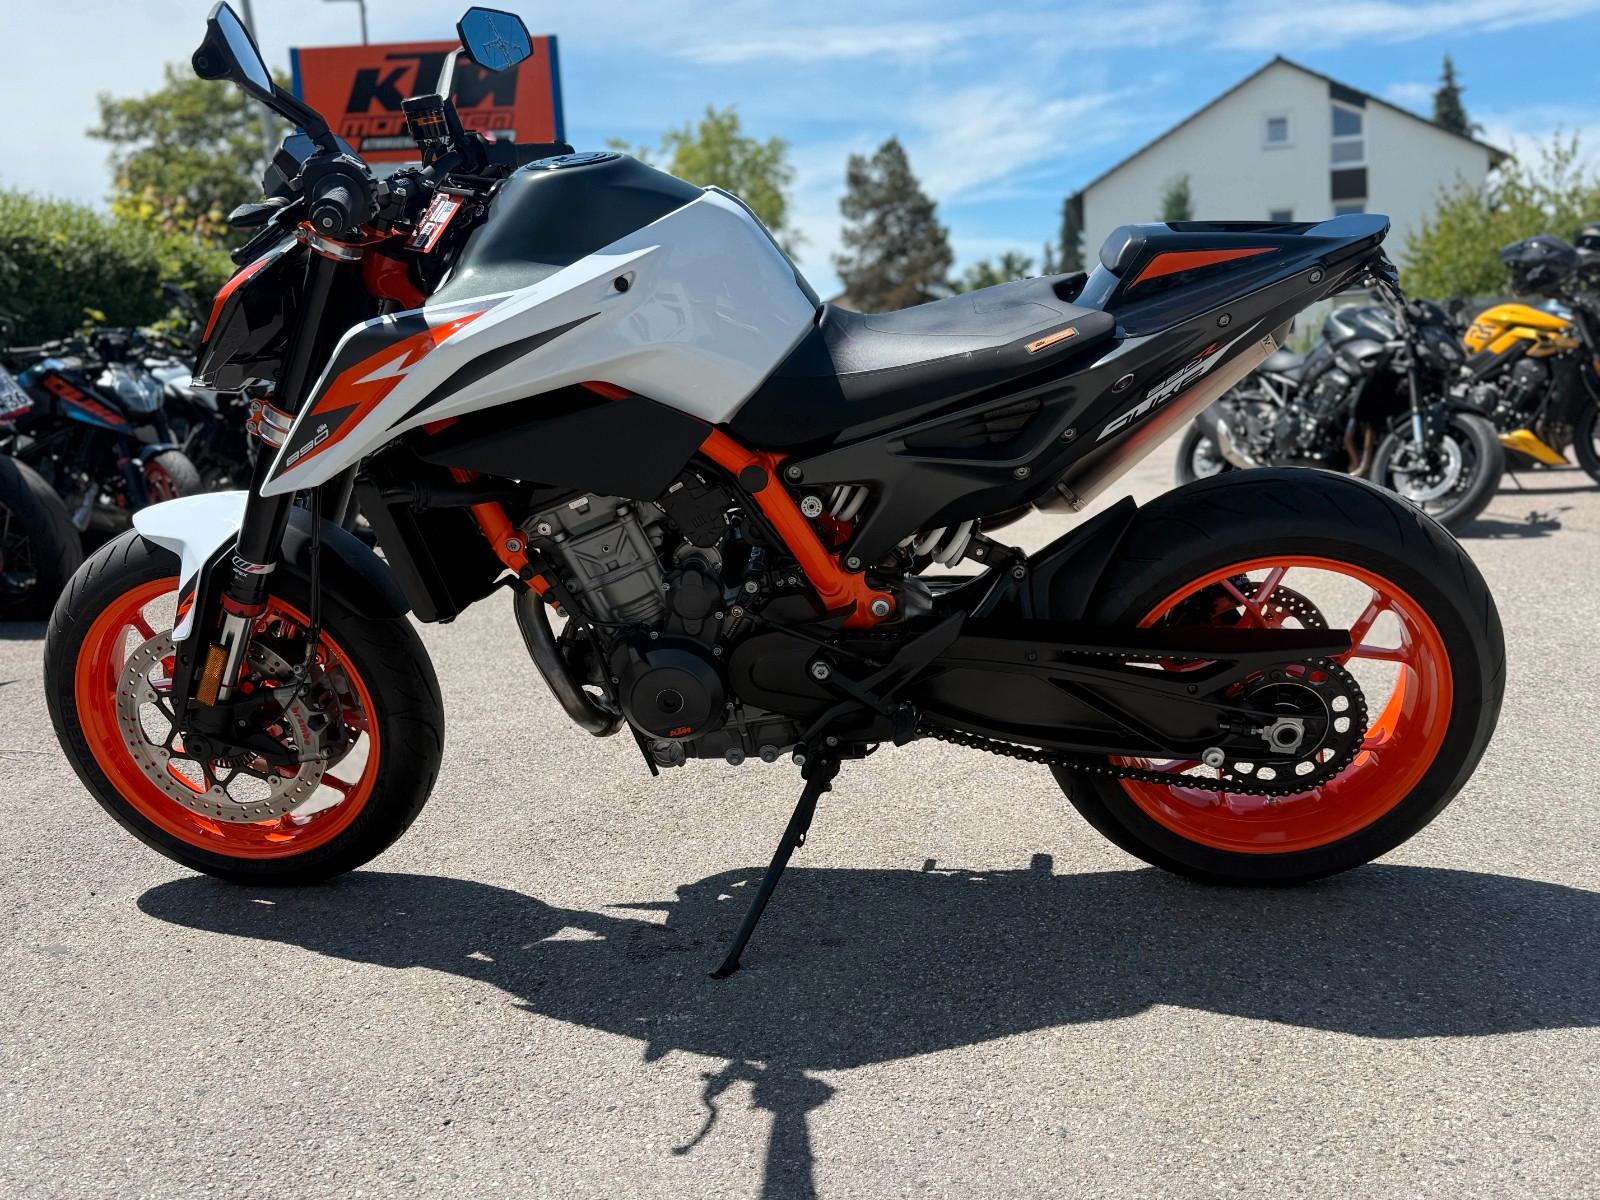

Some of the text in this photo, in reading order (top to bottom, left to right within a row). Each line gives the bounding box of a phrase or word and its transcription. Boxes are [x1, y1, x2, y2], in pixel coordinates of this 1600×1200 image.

[346, 51, 519, 113] KTM
[286, 428, 329, 467] 890
[290, 706, 311, 746] brembo
[670, 727, 693, 737] KTM
